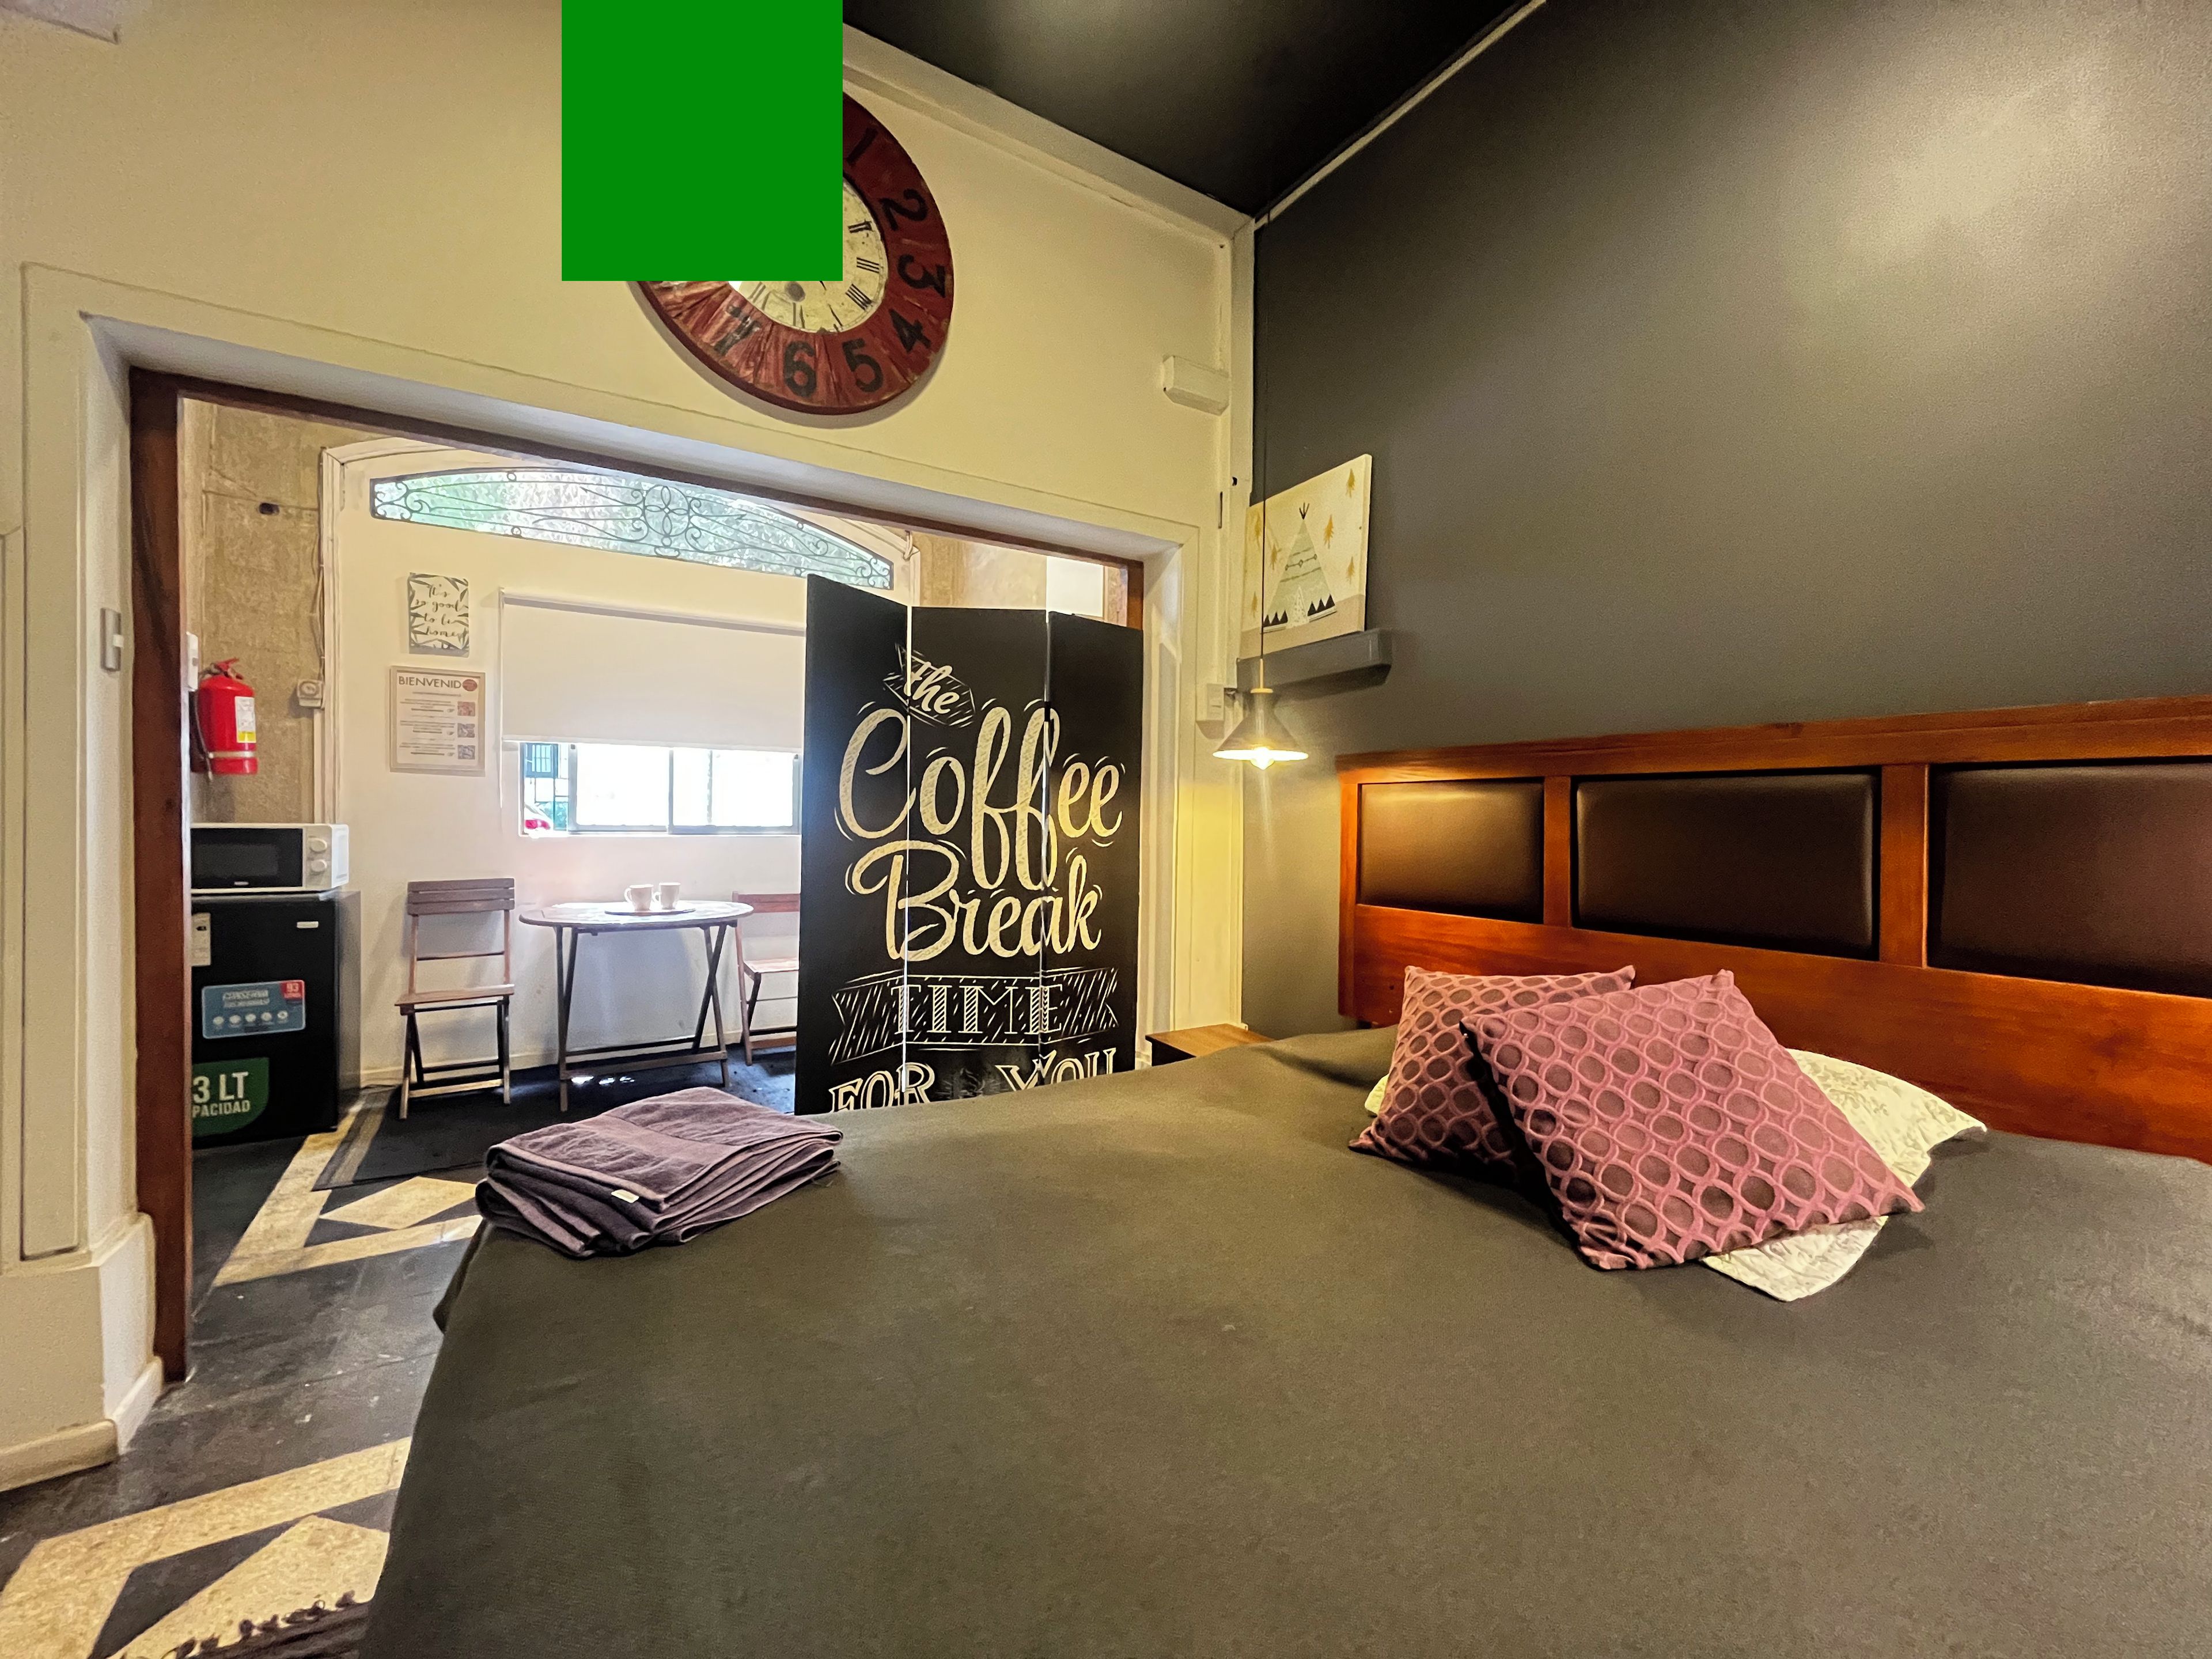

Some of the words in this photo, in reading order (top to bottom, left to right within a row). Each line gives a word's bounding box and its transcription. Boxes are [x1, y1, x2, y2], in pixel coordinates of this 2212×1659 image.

[878, 189, 928, 230] 2
[897, 255, 946, 298] 3
[889, 309, 931, 354] 4
[783, 340, 817, 398] 6
[842, 338, 884, 393] 5
[432, 600, 459, 613] good
[904, 662, 960, 714] the
[839, 706, 1123, 891] Coffee
[852, 840, 1101, 962] Break
[891, 984, 1063, 1035] TIME
[219, 1071, 249, 1101] LT
[828, 1062, 936, 1113] FOR
